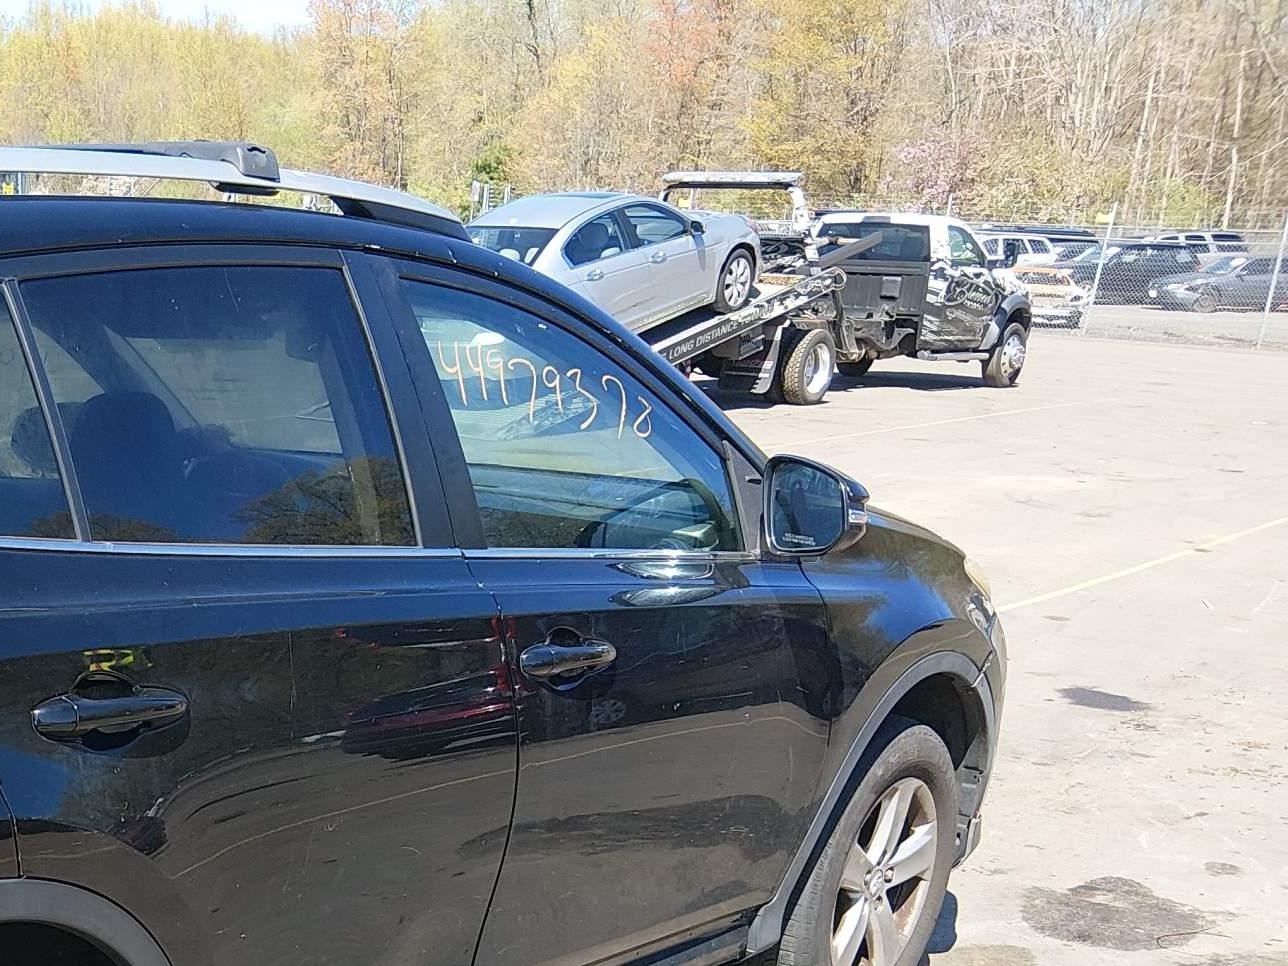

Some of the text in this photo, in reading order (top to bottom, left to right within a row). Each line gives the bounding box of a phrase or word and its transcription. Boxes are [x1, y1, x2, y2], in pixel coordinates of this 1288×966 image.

[669, 340, 695, 360] LONG
[696, 321, 738, 347] DISTANCE
[437, 340, 653, 440] 44979378
